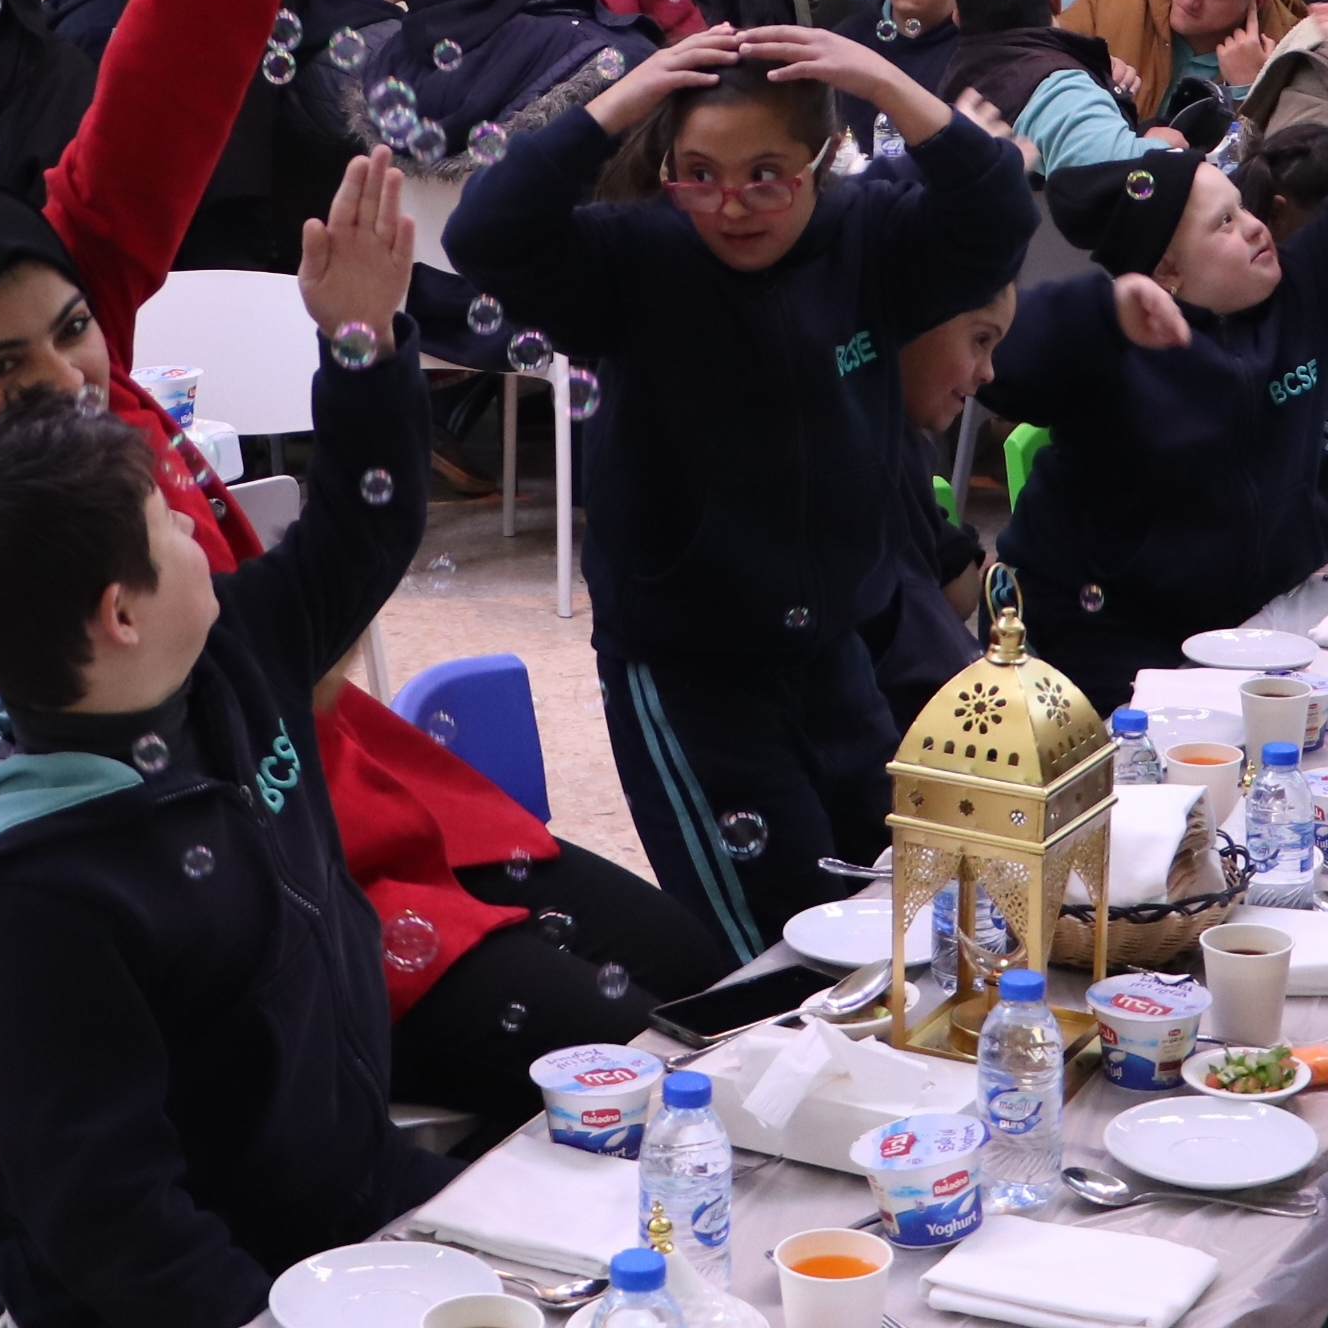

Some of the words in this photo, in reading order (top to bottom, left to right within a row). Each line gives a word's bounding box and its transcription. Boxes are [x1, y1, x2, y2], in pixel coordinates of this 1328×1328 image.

[1269, 358, 1317, 405] BCSE
[582, 1111, 620, 1124] Baladna
[934, 1175, 969, 1194] Baladna
[926, 1210, 978, 1238] Yoghurt
